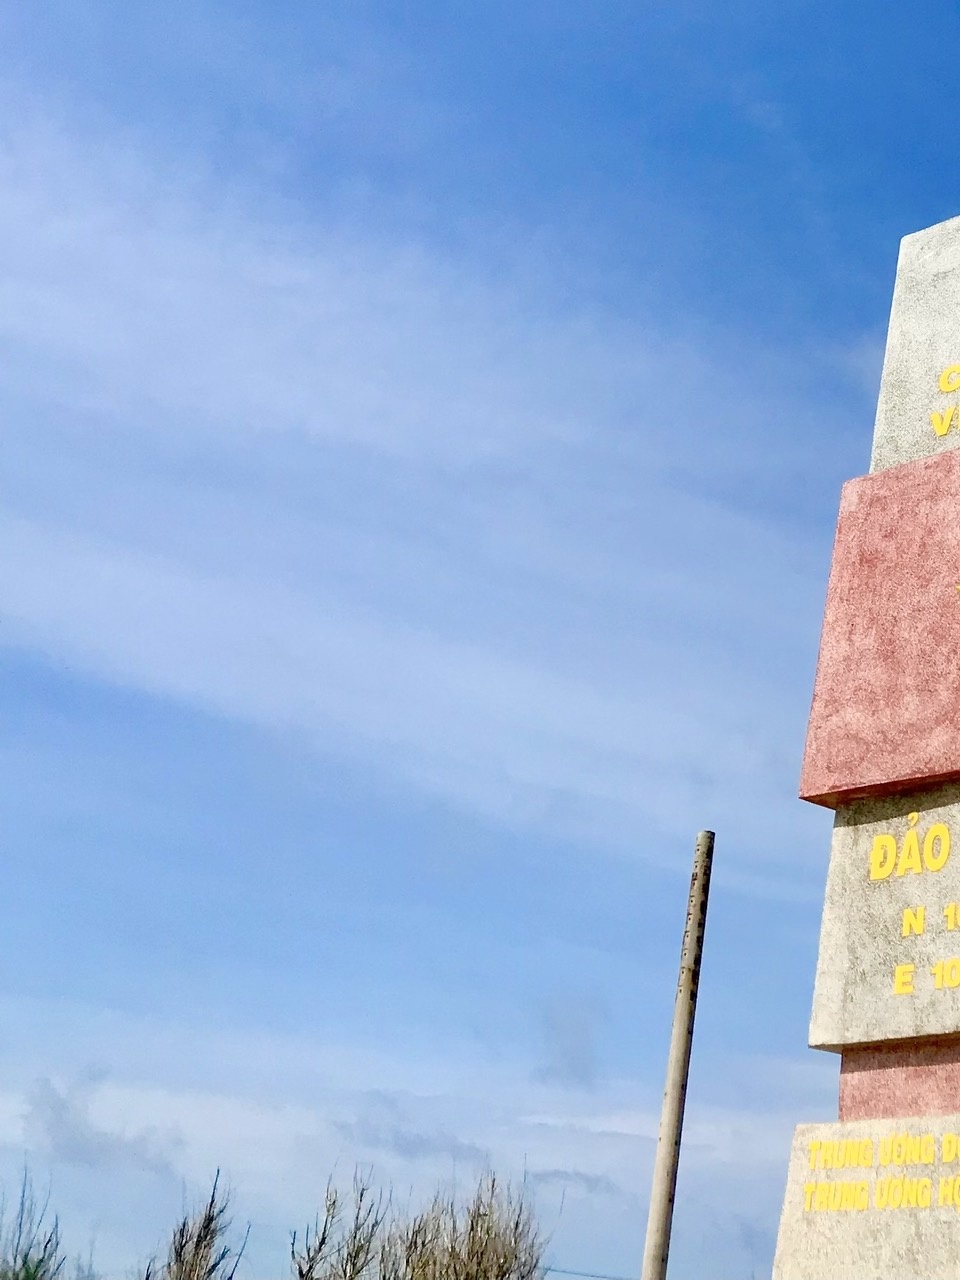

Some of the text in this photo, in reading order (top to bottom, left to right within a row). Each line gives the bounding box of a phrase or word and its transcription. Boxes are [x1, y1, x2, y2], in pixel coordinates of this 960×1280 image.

[869, 811, 951, 881] ĐẢO
[902, 906, 926, 937] N
[893, 964, 915, 995] E
[809, 1138, 874, 1170] TRUNG
[803, 1180, 869, 1212] TRUNG
